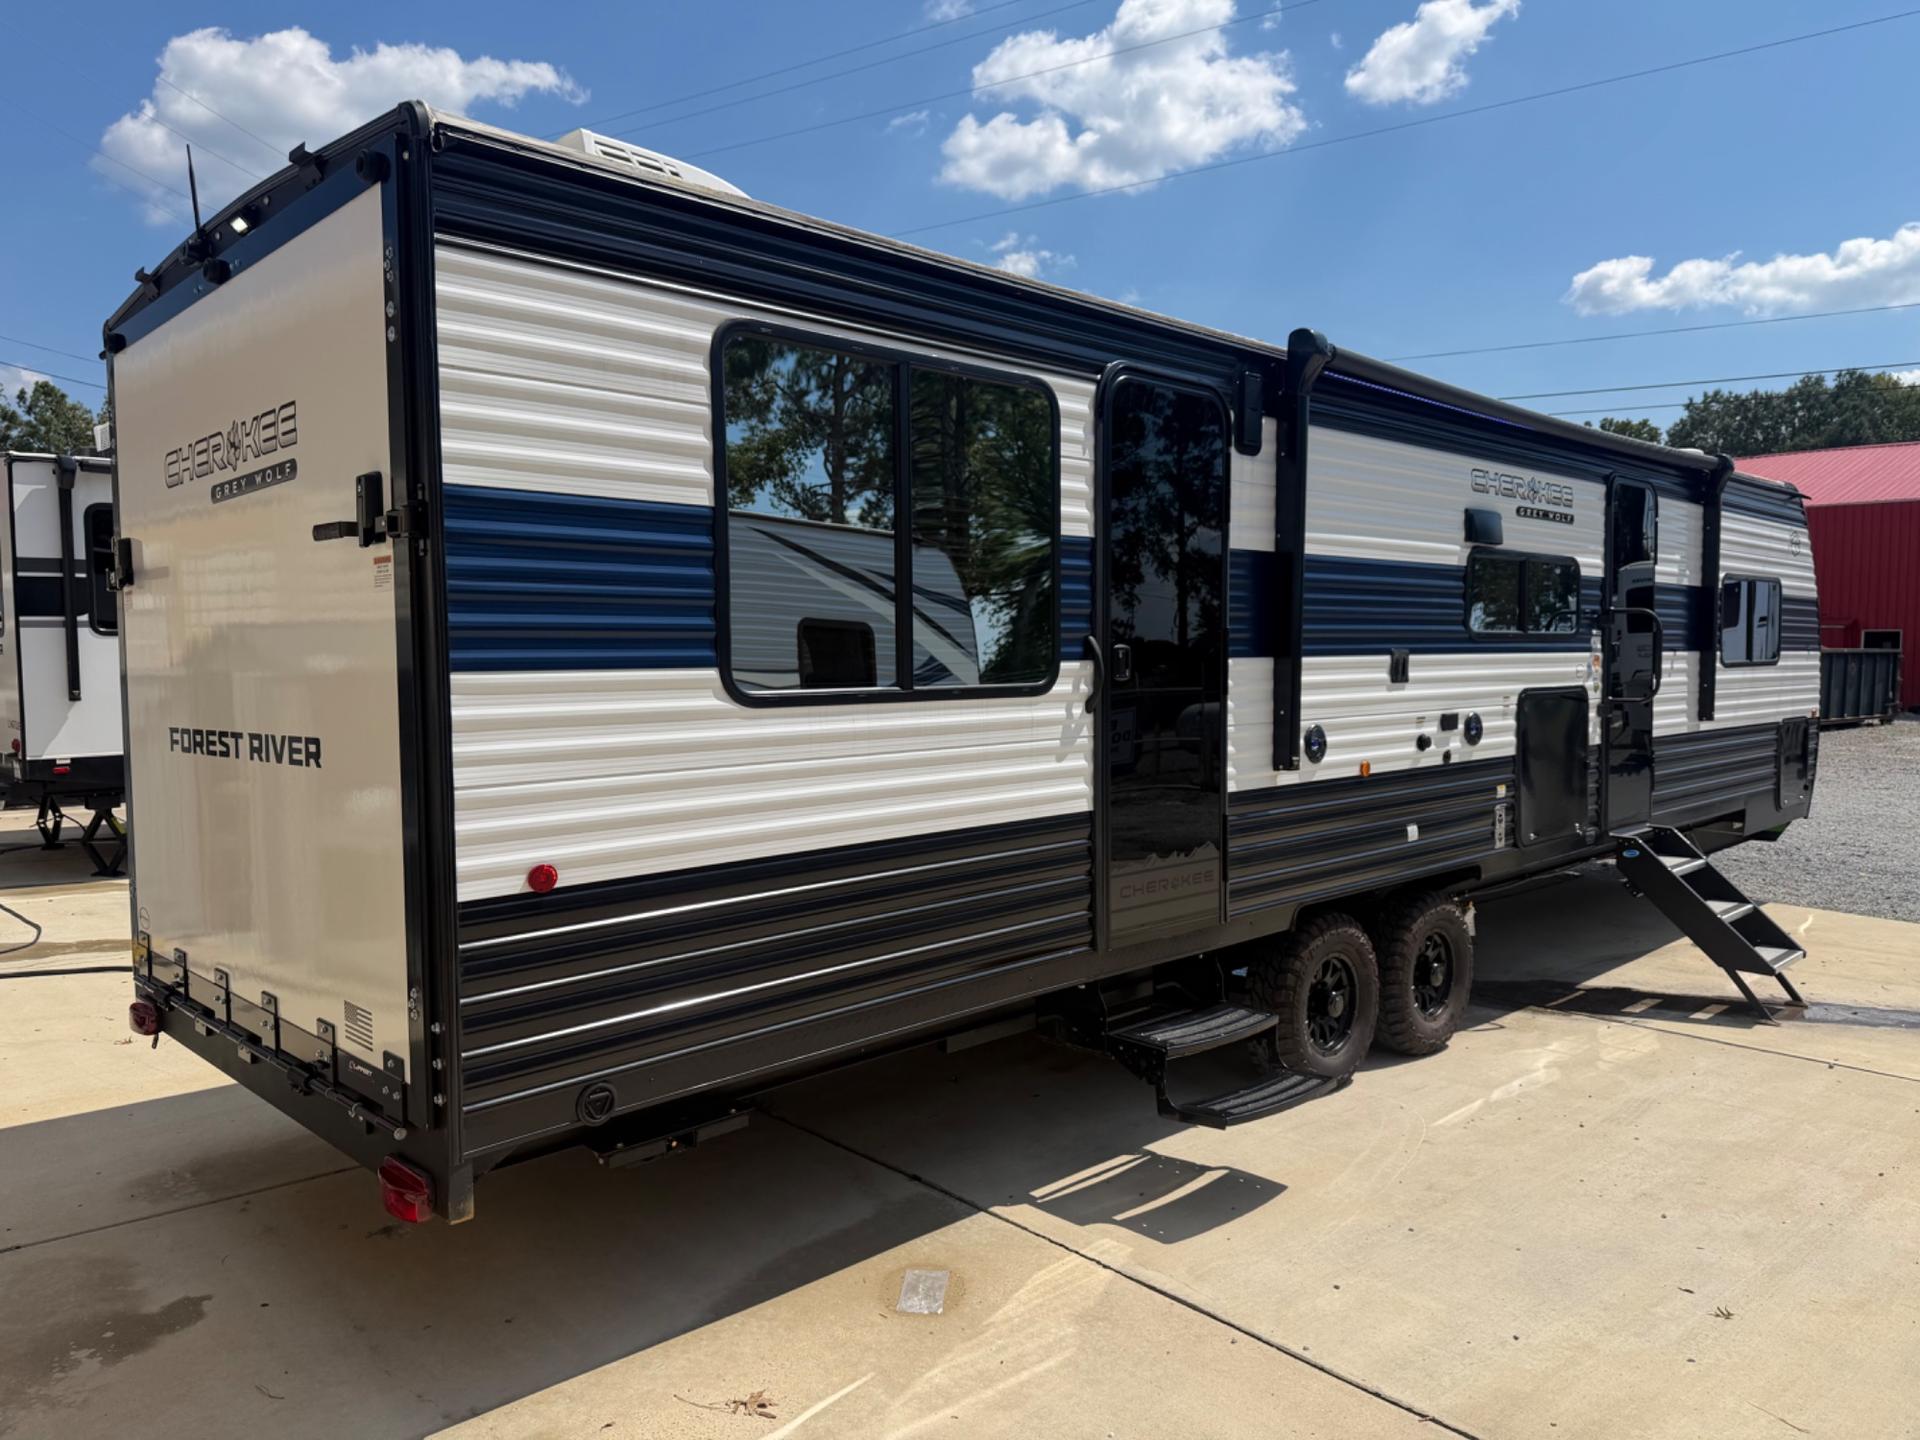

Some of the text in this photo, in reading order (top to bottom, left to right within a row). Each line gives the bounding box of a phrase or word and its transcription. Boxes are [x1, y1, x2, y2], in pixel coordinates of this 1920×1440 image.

[164, 400, 297, 489] CHEROKEE
[215, 462, 292, 499] GREY WOLF
[1471, 468, 1573, 508] CHEROKEE
[1519, 506, 1572, 523] GREY WOLF
[168, 727, 322, 769] FOREST RIVER
